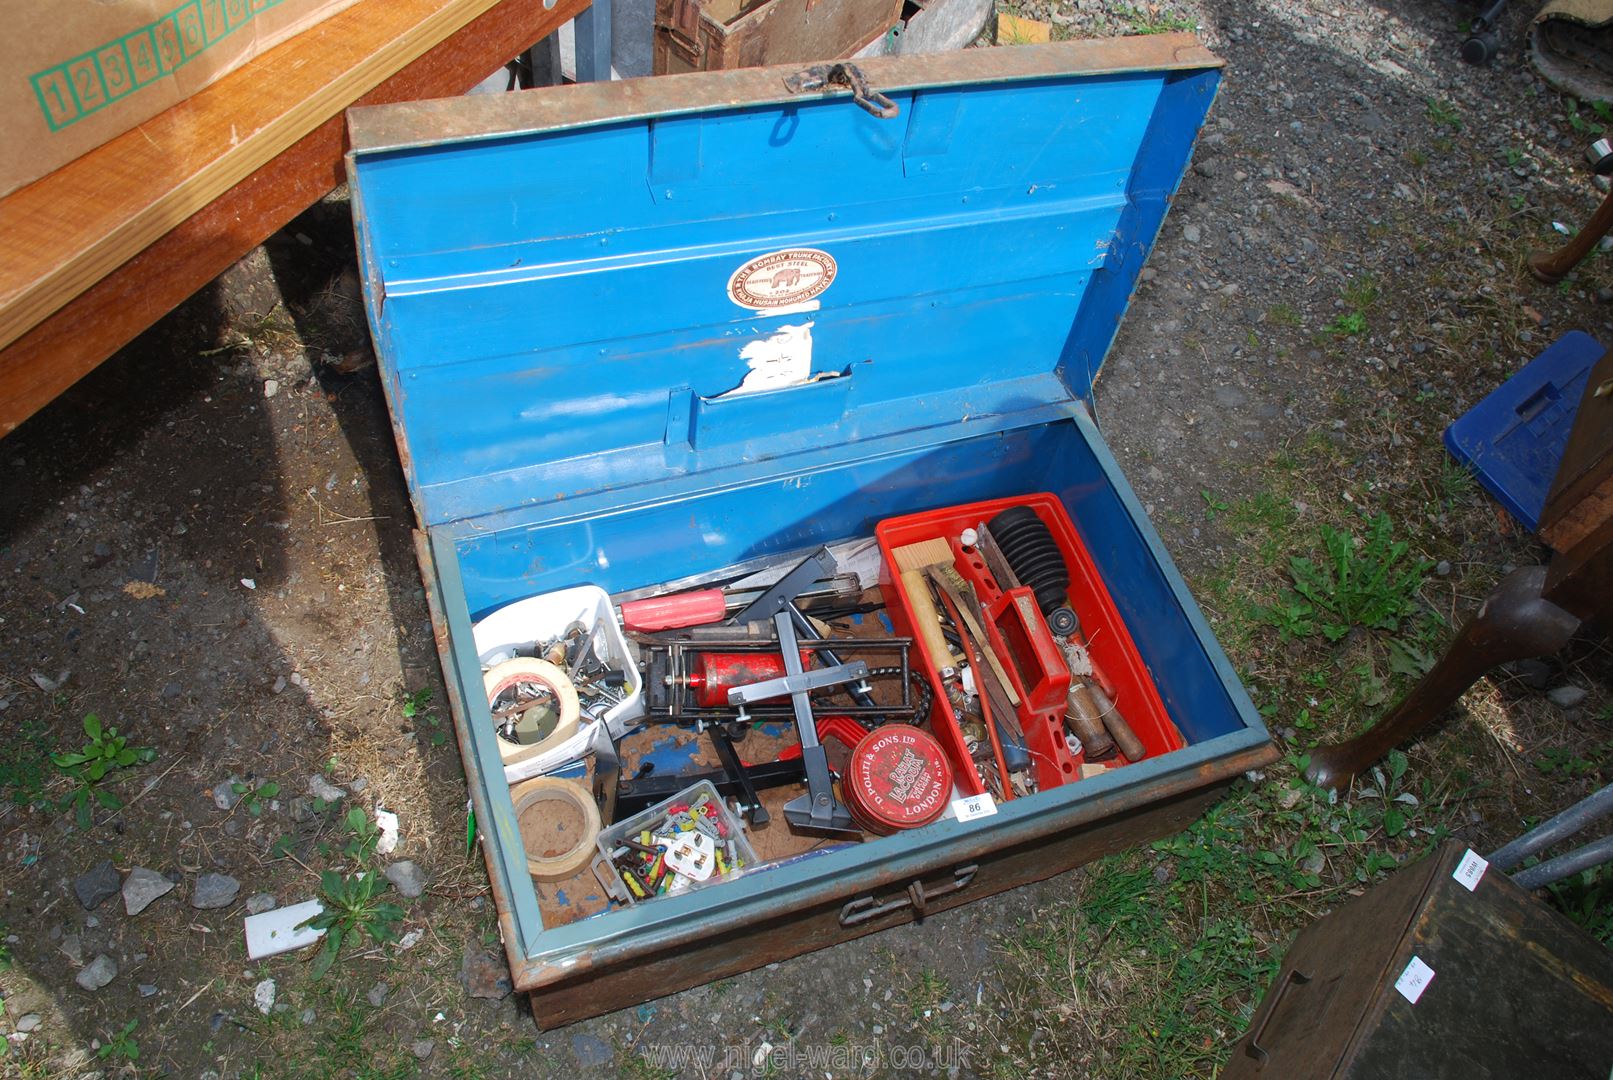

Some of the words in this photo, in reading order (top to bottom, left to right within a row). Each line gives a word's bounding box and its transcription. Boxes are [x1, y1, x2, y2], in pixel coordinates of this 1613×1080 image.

[46, 80, 66, 113] 1
[76, 67, 98, 101] 2
[105, 54, 124, 87] 3
[137, 40, 151, 72] 4
[160, 28, 175, 62] 5
[184, 13, 198, 45] 6
[969, 803, 981, 813] 86
